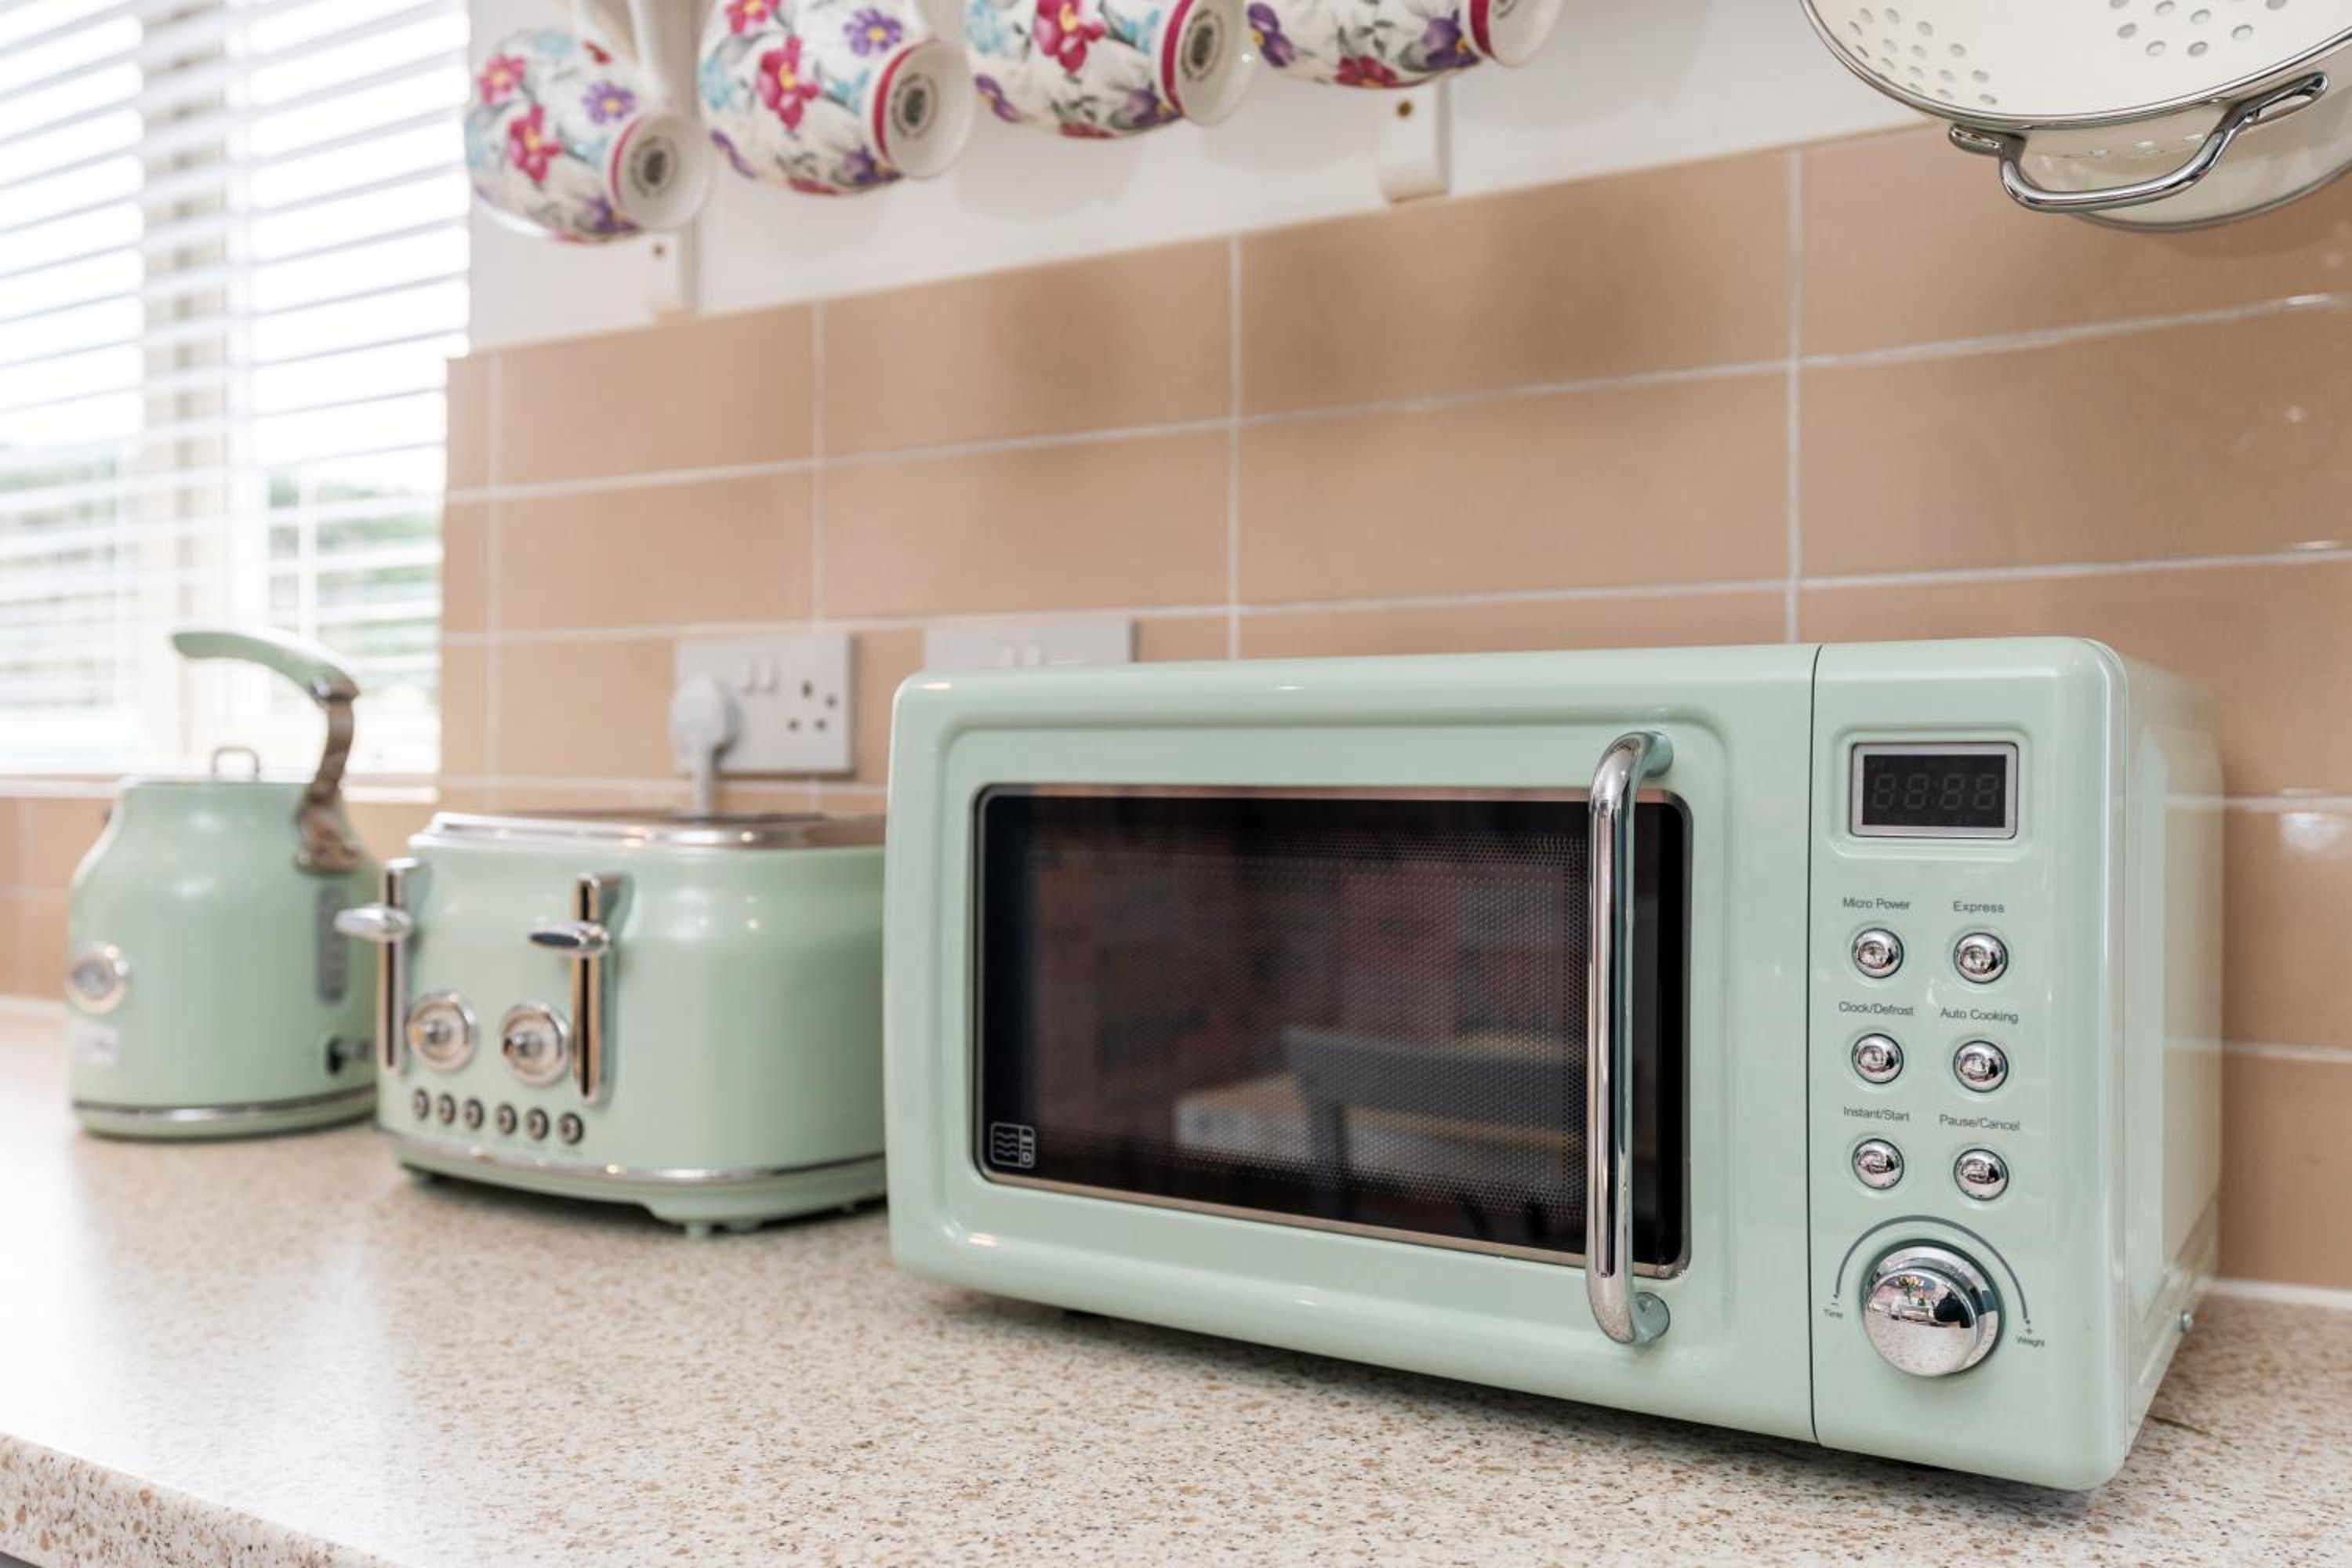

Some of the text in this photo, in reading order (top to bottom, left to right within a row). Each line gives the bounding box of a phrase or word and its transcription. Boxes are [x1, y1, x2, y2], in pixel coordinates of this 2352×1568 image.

[1843, 897, 1910, 910] Micro Power
[1953, 901, 2005, 914] Express
[1838, 1001, 1914, 1017] Clock/Defrost
[1940, 1007, 2019, 1025] Auto Cooking
[1842, 1105, 1910, 1123] Instant/Start
[1940, 1114, 2020, 1131] Pause/Cancel
